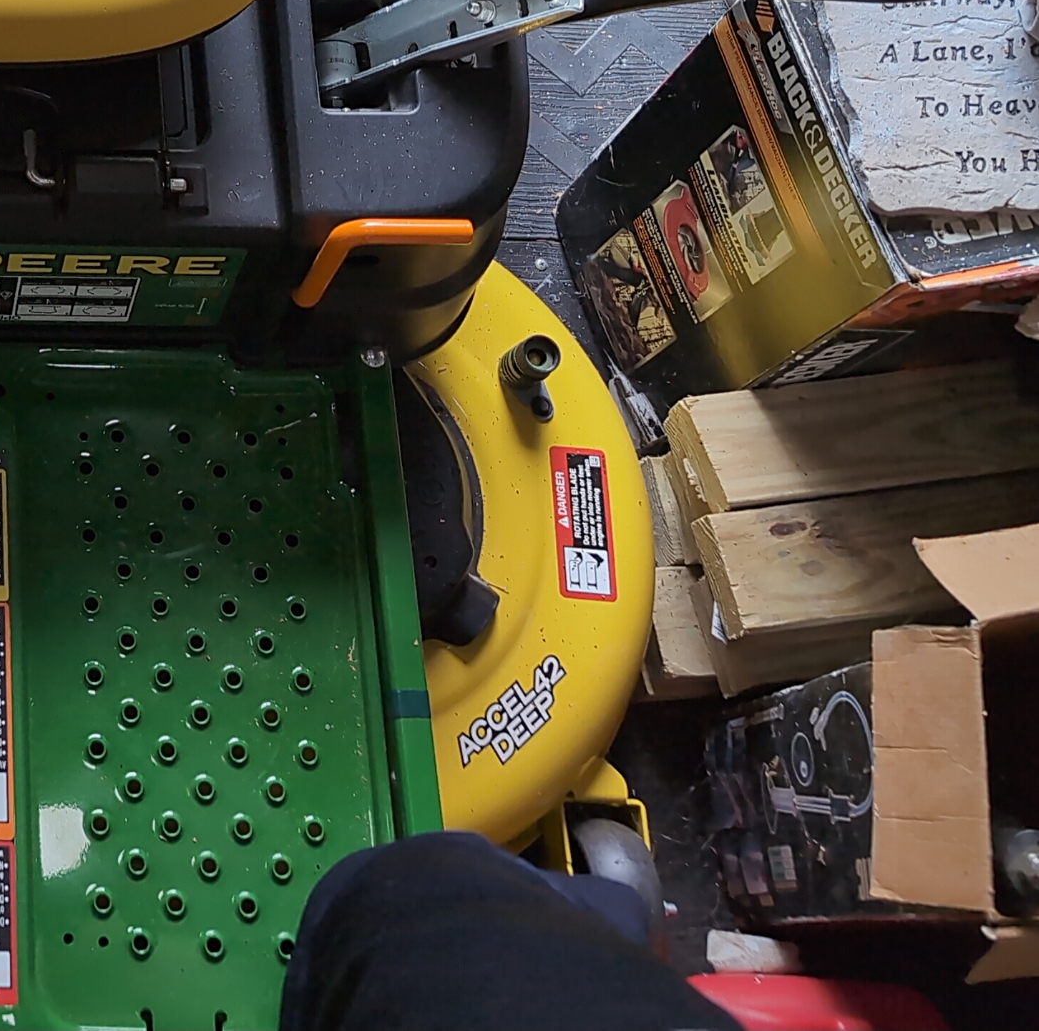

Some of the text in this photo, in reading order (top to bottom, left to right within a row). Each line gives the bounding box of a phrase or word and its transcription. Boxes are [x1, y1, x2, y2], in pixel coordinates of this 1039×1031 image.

[879, 43, 898, 64] A
[912, 40, 994, 64] Lane,
[915, 94, 1039, 118] To Heav
[955, 150, 1007, 173] You
[555, 470, 567, 516] DANGER
[569, 467, 581, 538] ROTATING BLADE
[490, 690, 555, 765] DEEP
